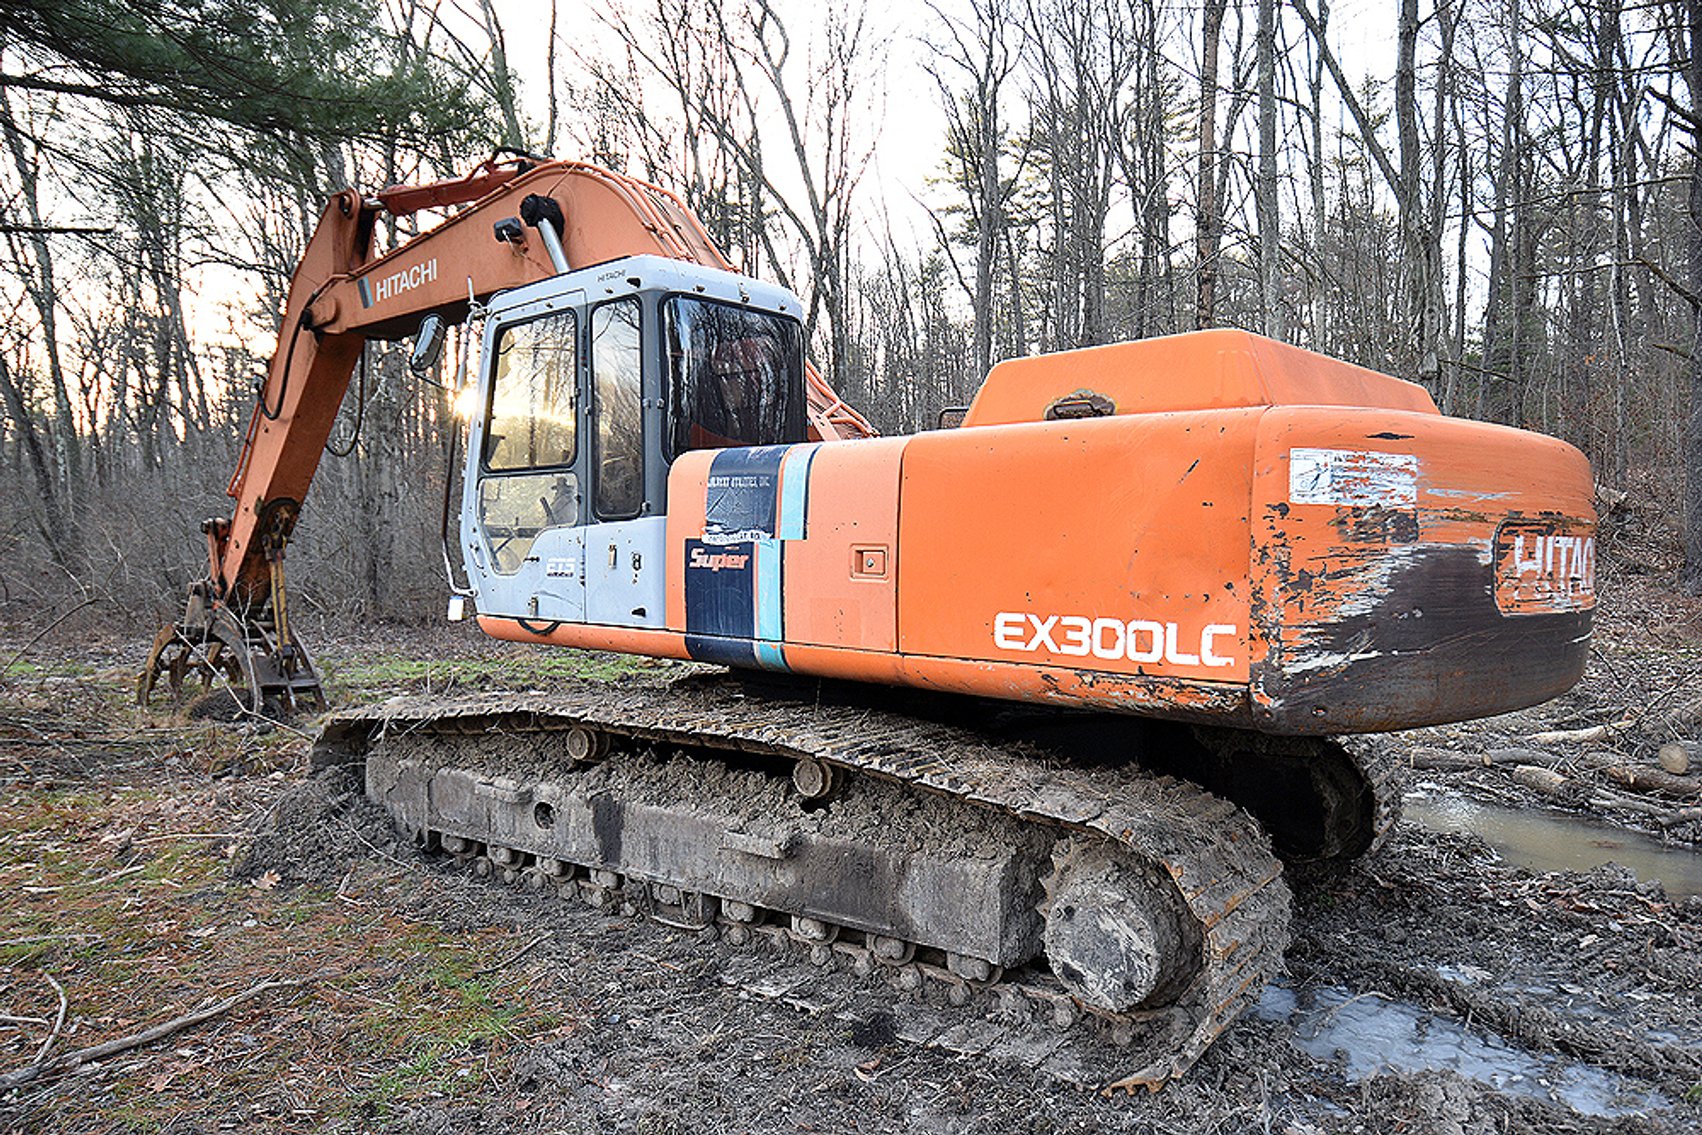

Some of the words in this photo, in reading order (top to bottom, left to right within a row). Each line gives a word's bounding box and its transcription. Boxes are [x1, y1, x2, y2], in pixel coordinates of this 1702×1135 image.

[376, 258, 437, 302] HITACHI
[597, 269, 626, 282] HITACHI
[689, 548, 749, 572] Super
[993, 612, 1237, 667] EX300LC
